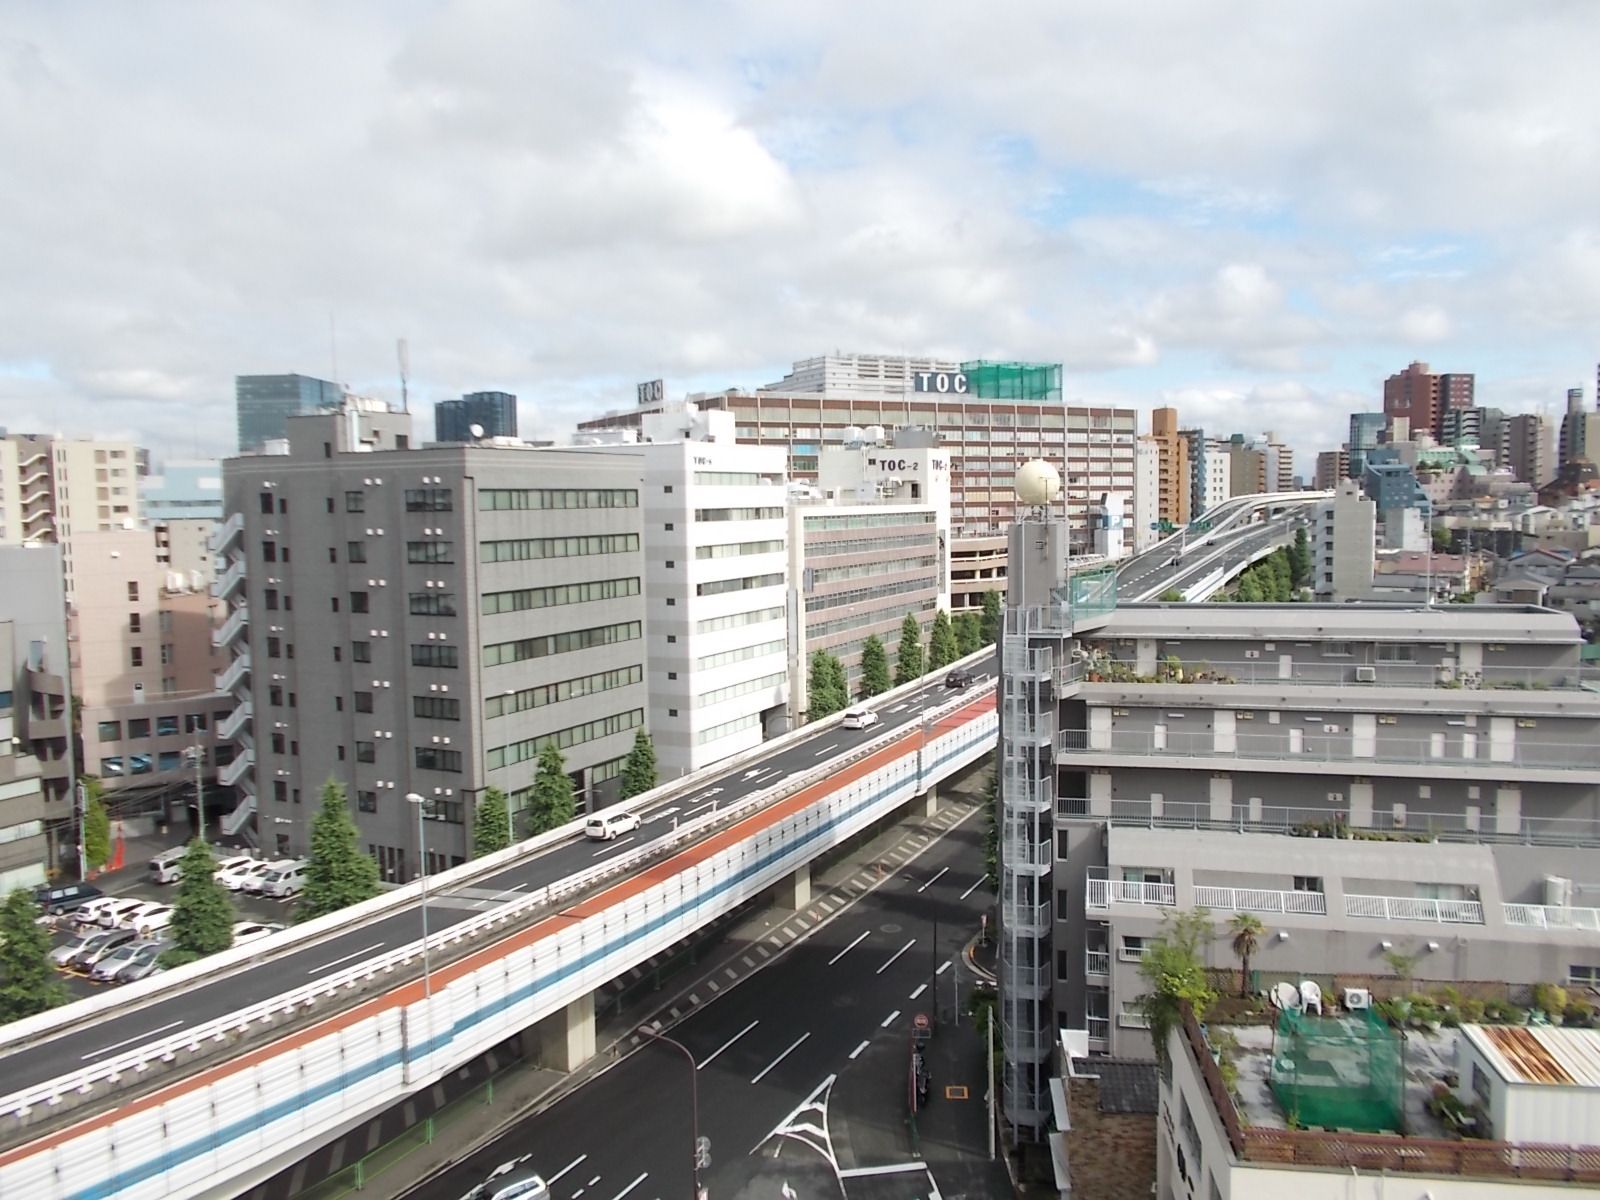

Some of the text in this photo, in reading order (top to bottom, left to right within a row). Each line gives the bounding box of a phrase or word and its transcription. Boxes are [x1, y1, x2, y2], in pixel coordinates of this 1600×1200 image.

[640, 380, 661, 403] TOC
[919, 373, 967, 393] TOC
[880, 460, 919, 471] TOC-2
